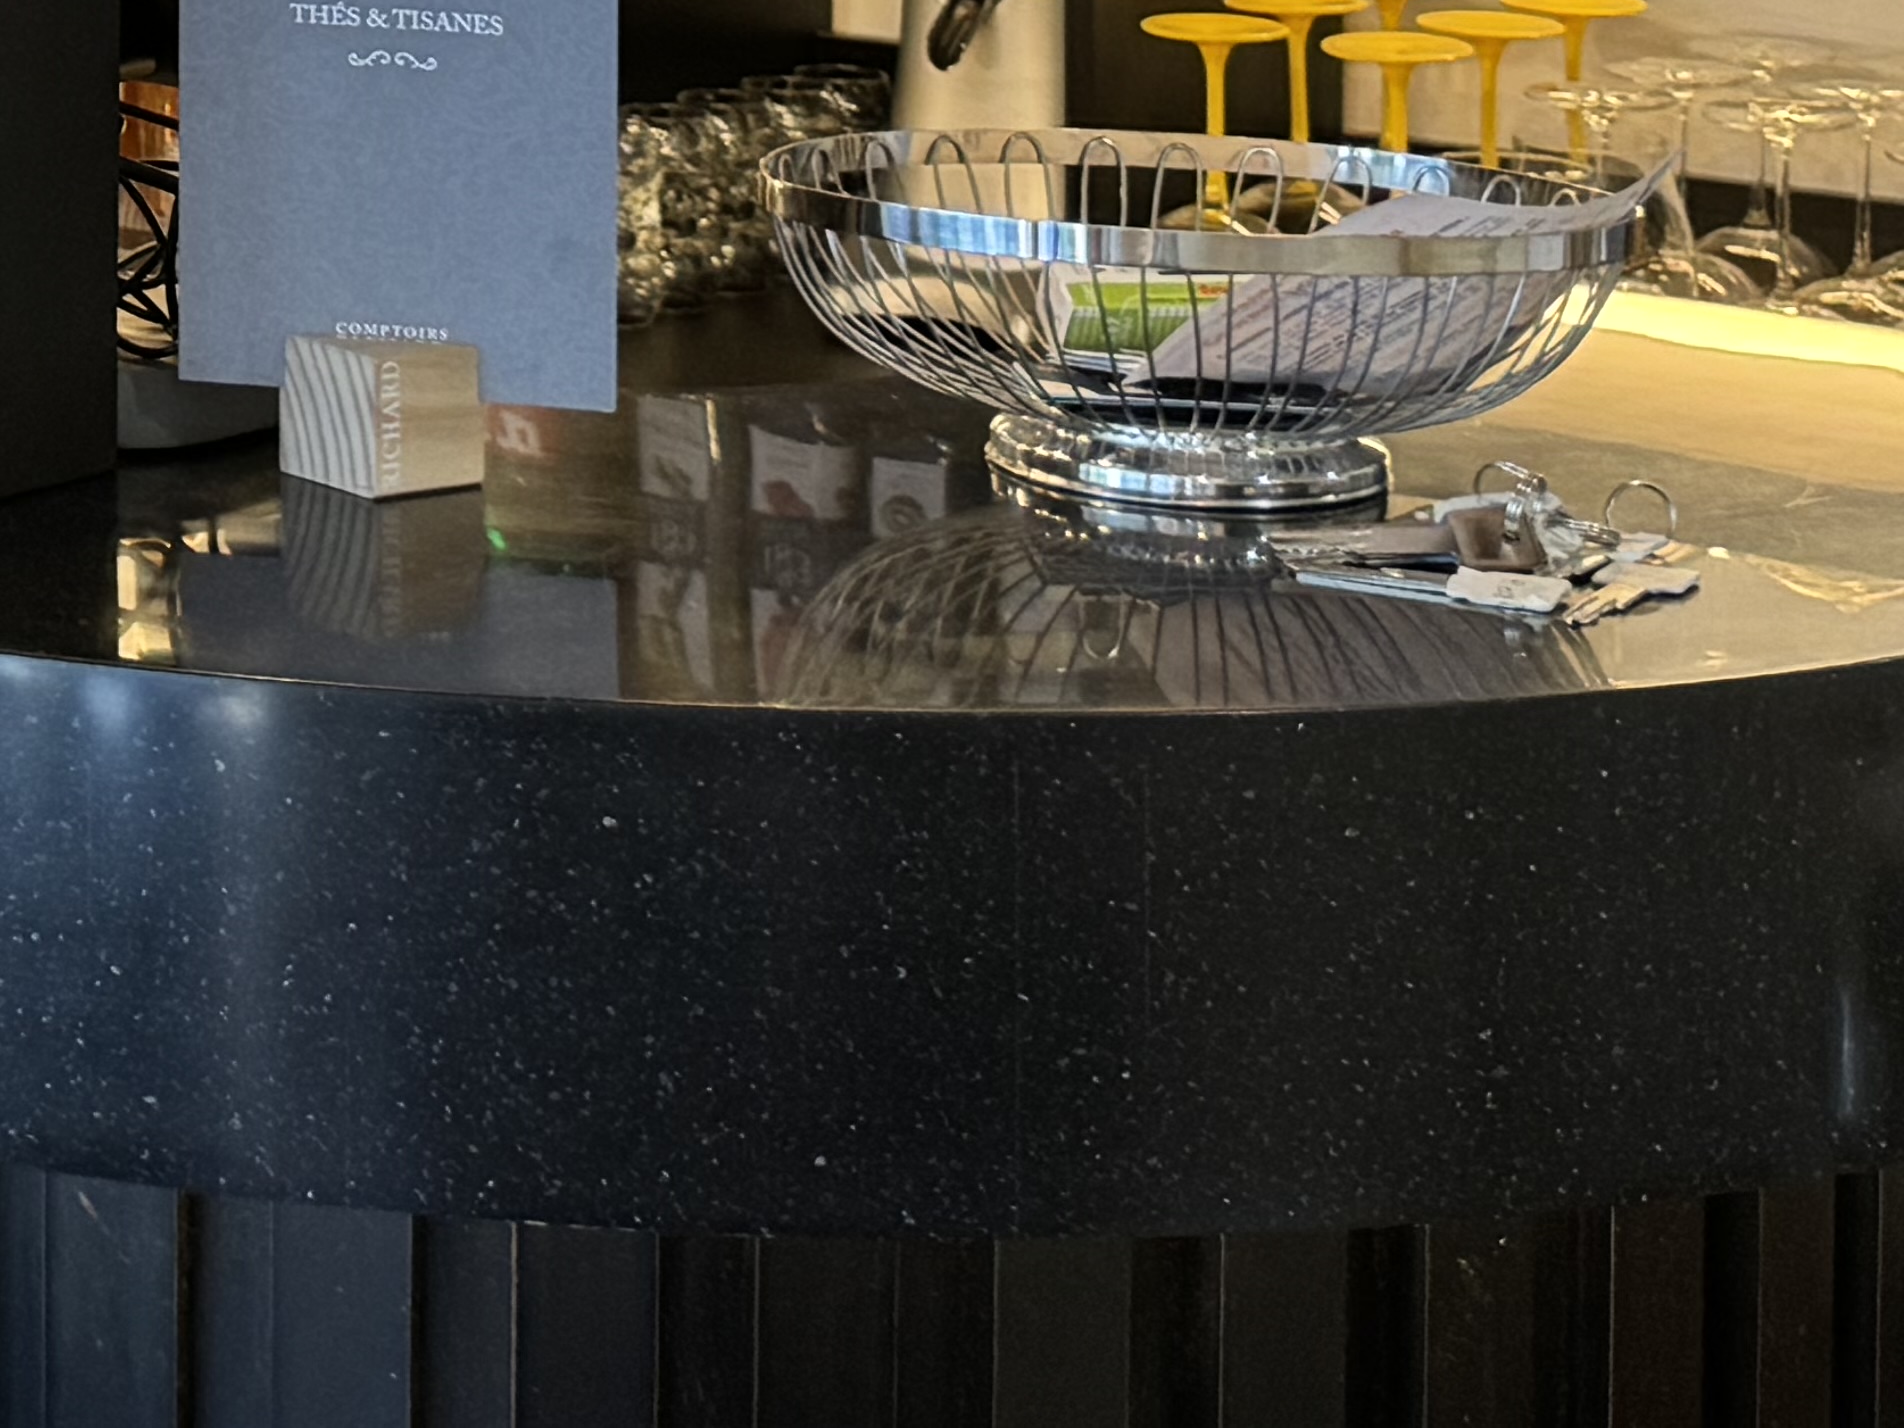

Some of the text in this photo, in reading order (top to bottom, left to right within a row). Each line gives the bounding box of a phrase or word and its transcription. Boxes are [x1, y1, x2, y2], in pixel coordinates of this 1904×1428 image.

[366, 7, 391, 28] &
[391, 8, 504, 37] TISANES
[335, 321, 449, 342] COMPTOIRS
[381, 360, 401, 492] RICHARD
